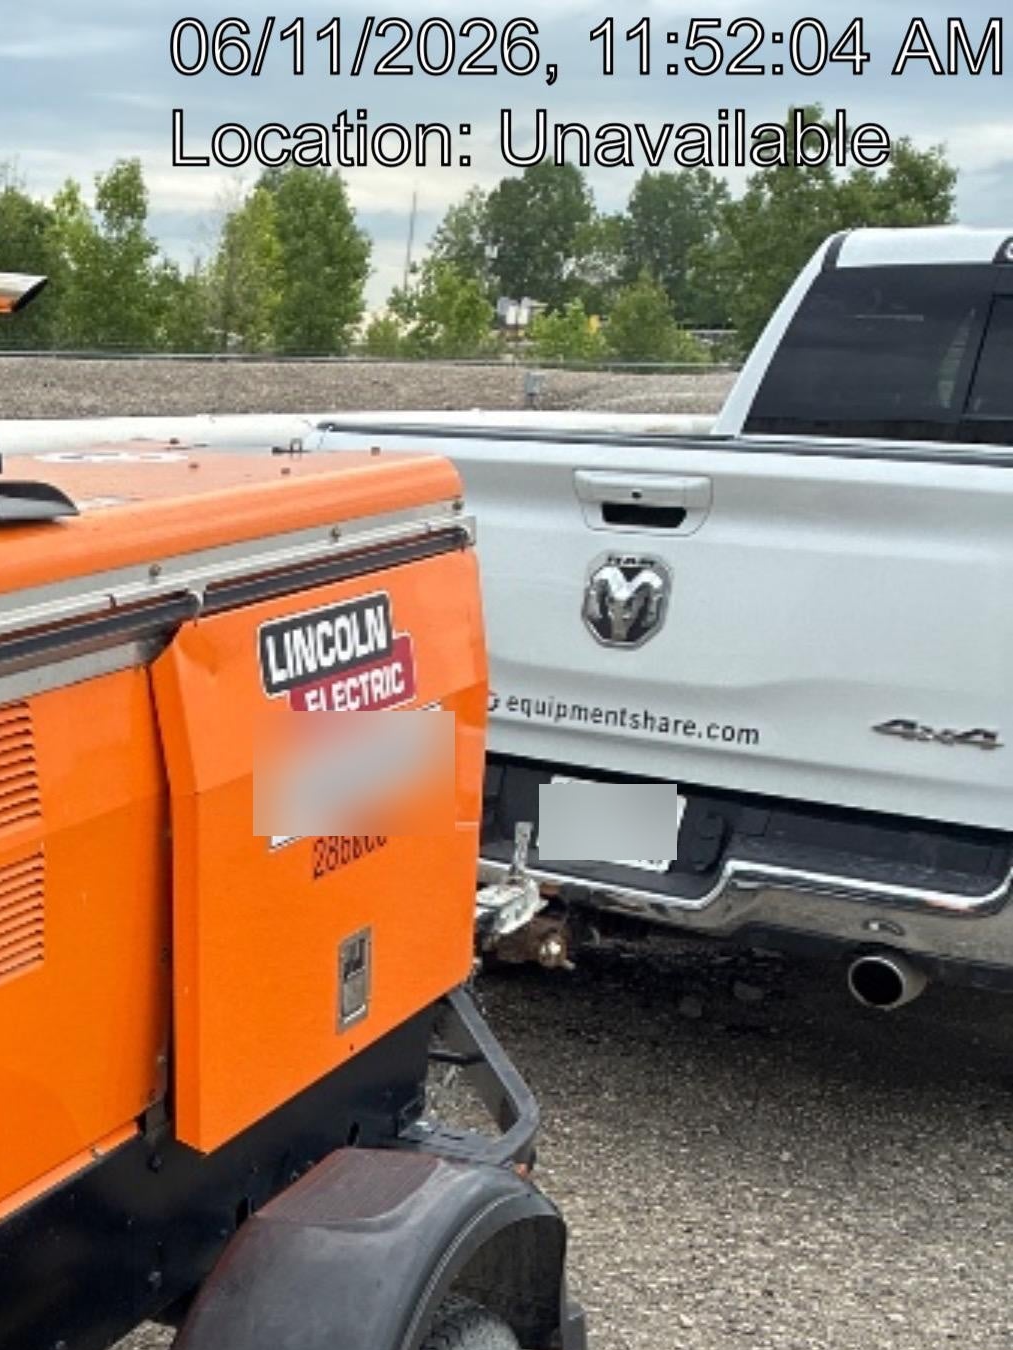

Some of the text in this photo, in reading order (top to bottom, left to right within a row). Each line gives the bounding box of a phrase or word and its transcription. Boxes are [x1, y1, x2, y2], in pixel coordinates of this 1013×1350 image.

[266, 604, 388, 684] LINCOLN
[304, 661, 406, 711] ELECTRIC
[506, 694, 760, 745] equipmentshare.com
